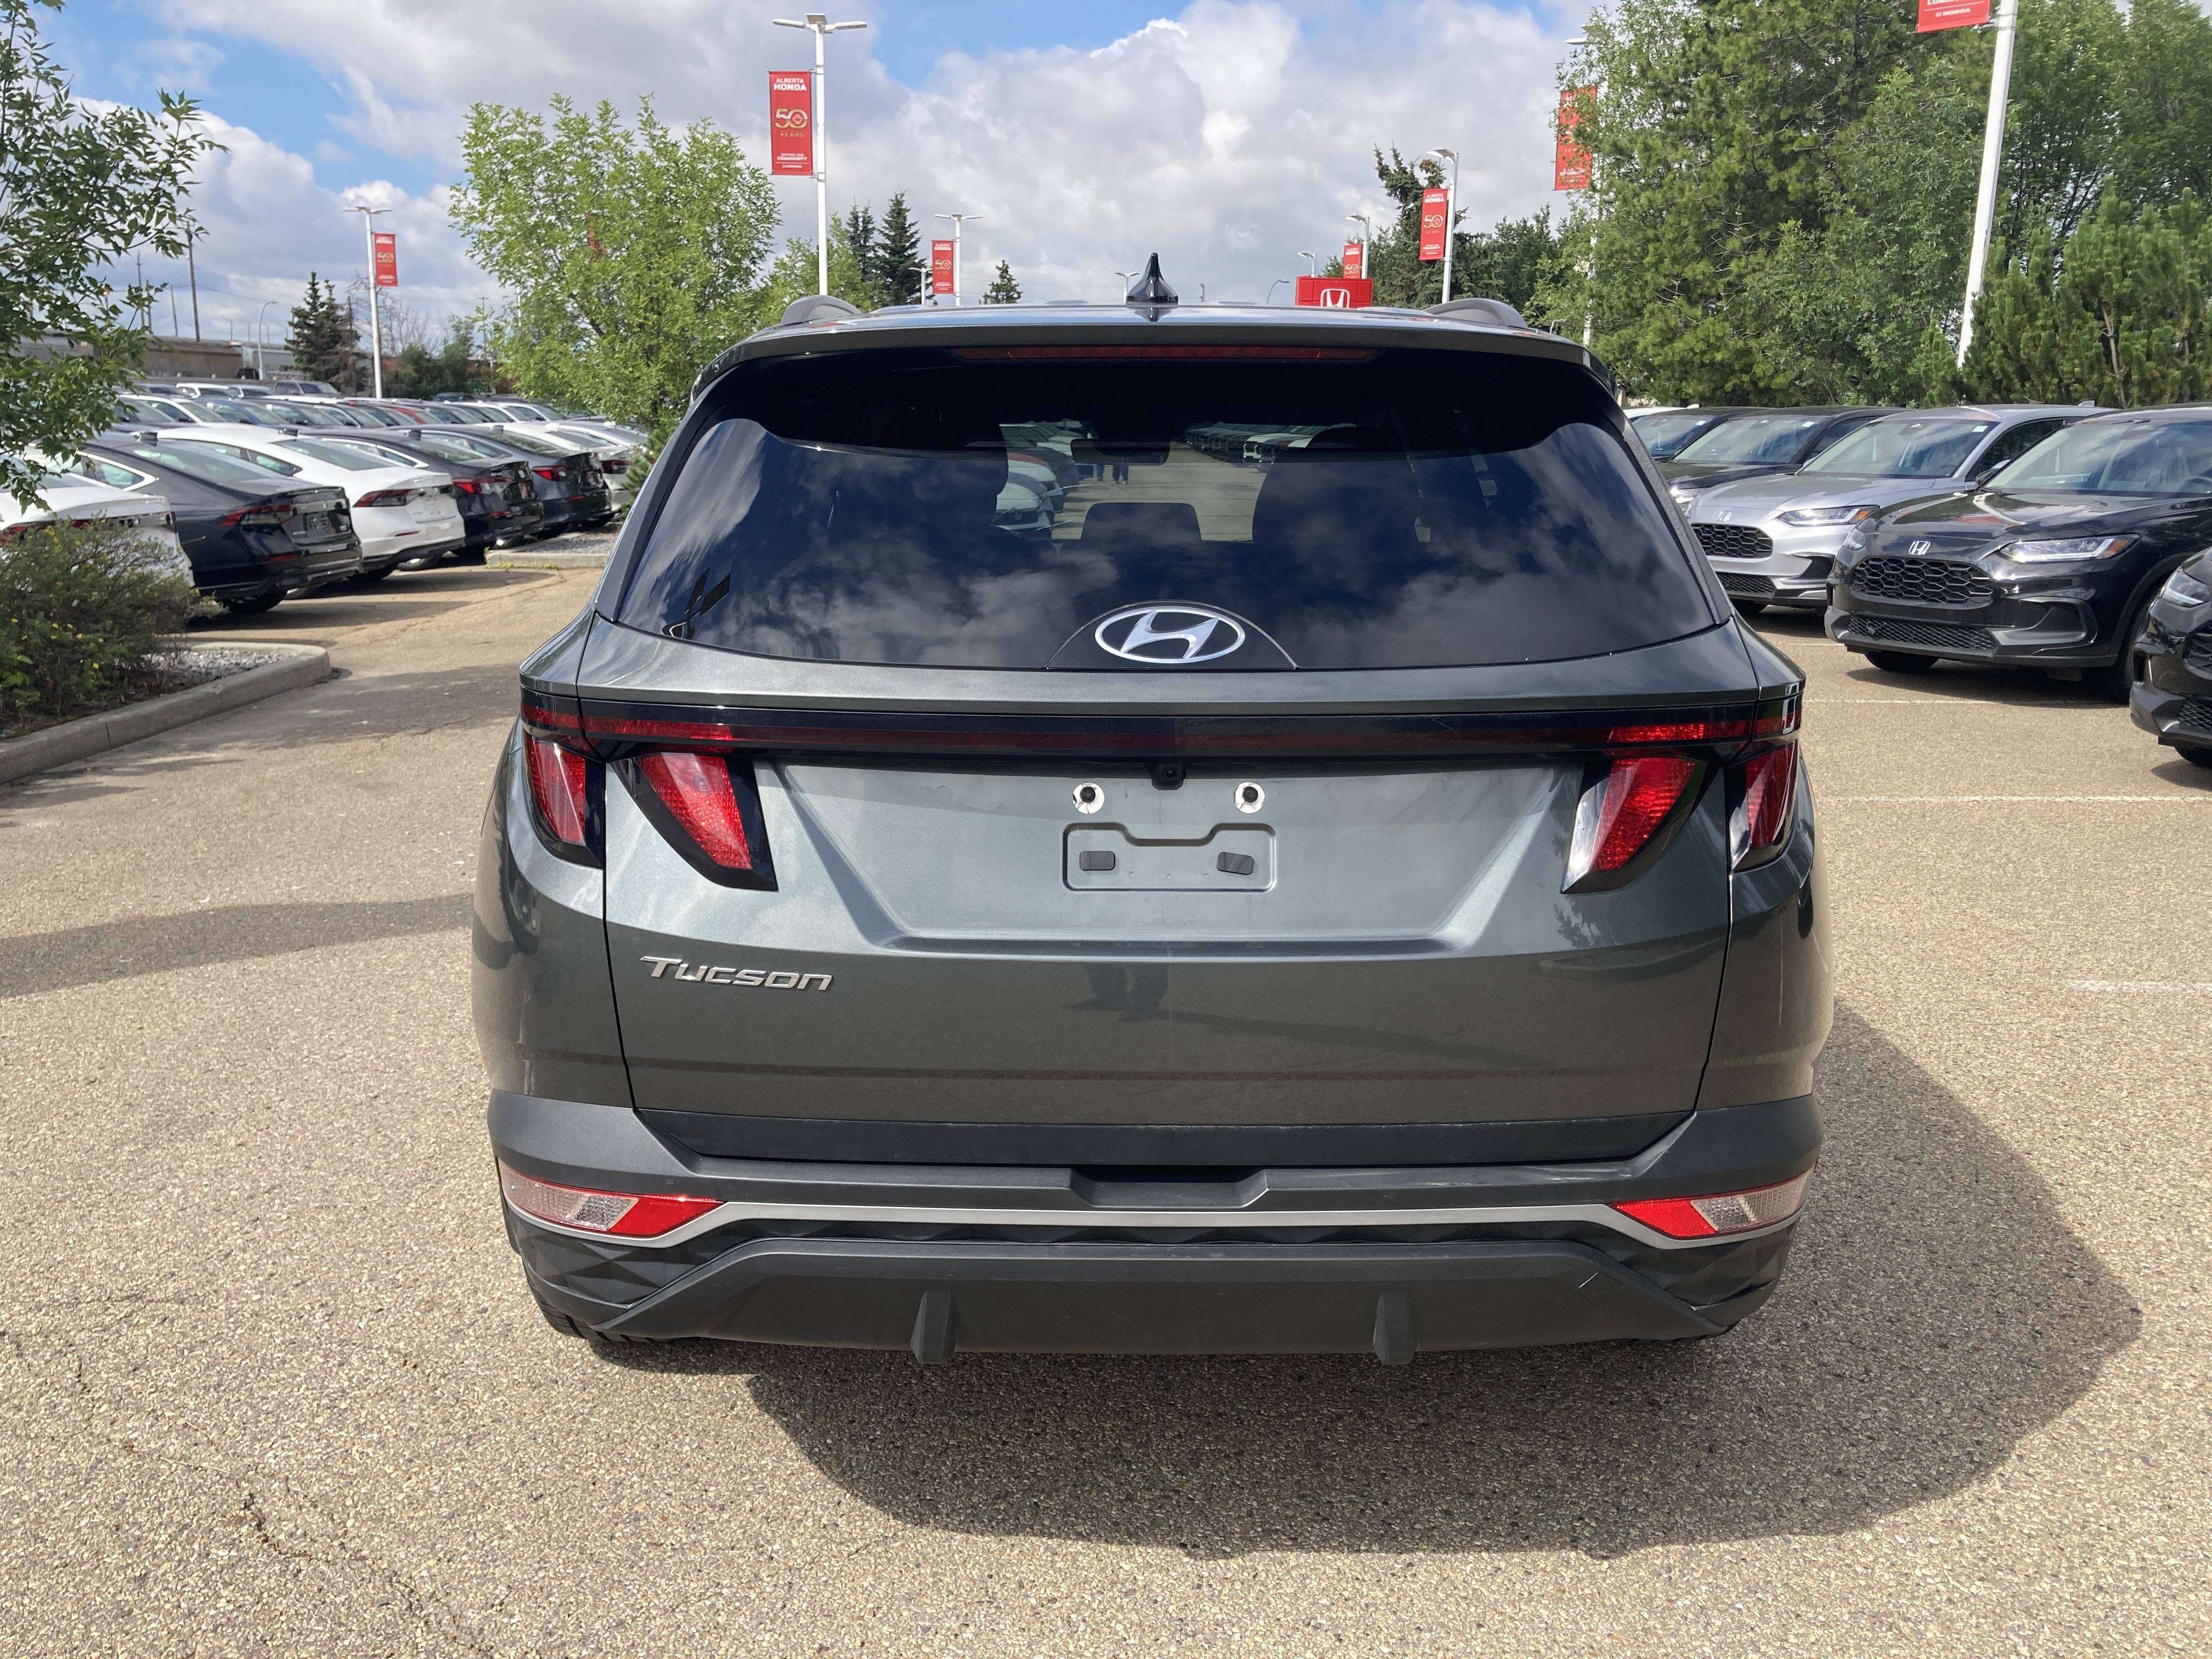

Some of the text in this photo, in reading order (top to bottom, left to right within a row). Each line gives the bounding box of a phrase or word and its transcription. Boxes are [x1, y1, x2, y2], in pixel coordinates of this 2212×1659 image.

[1943, 8, 1971, 16] HONDA
[775, 108, 808, 129] 50
[1423, 214, 1443, 229] 50
[935, 259, 952, 270] 50
[1345, 263, 1359, 274] 50
